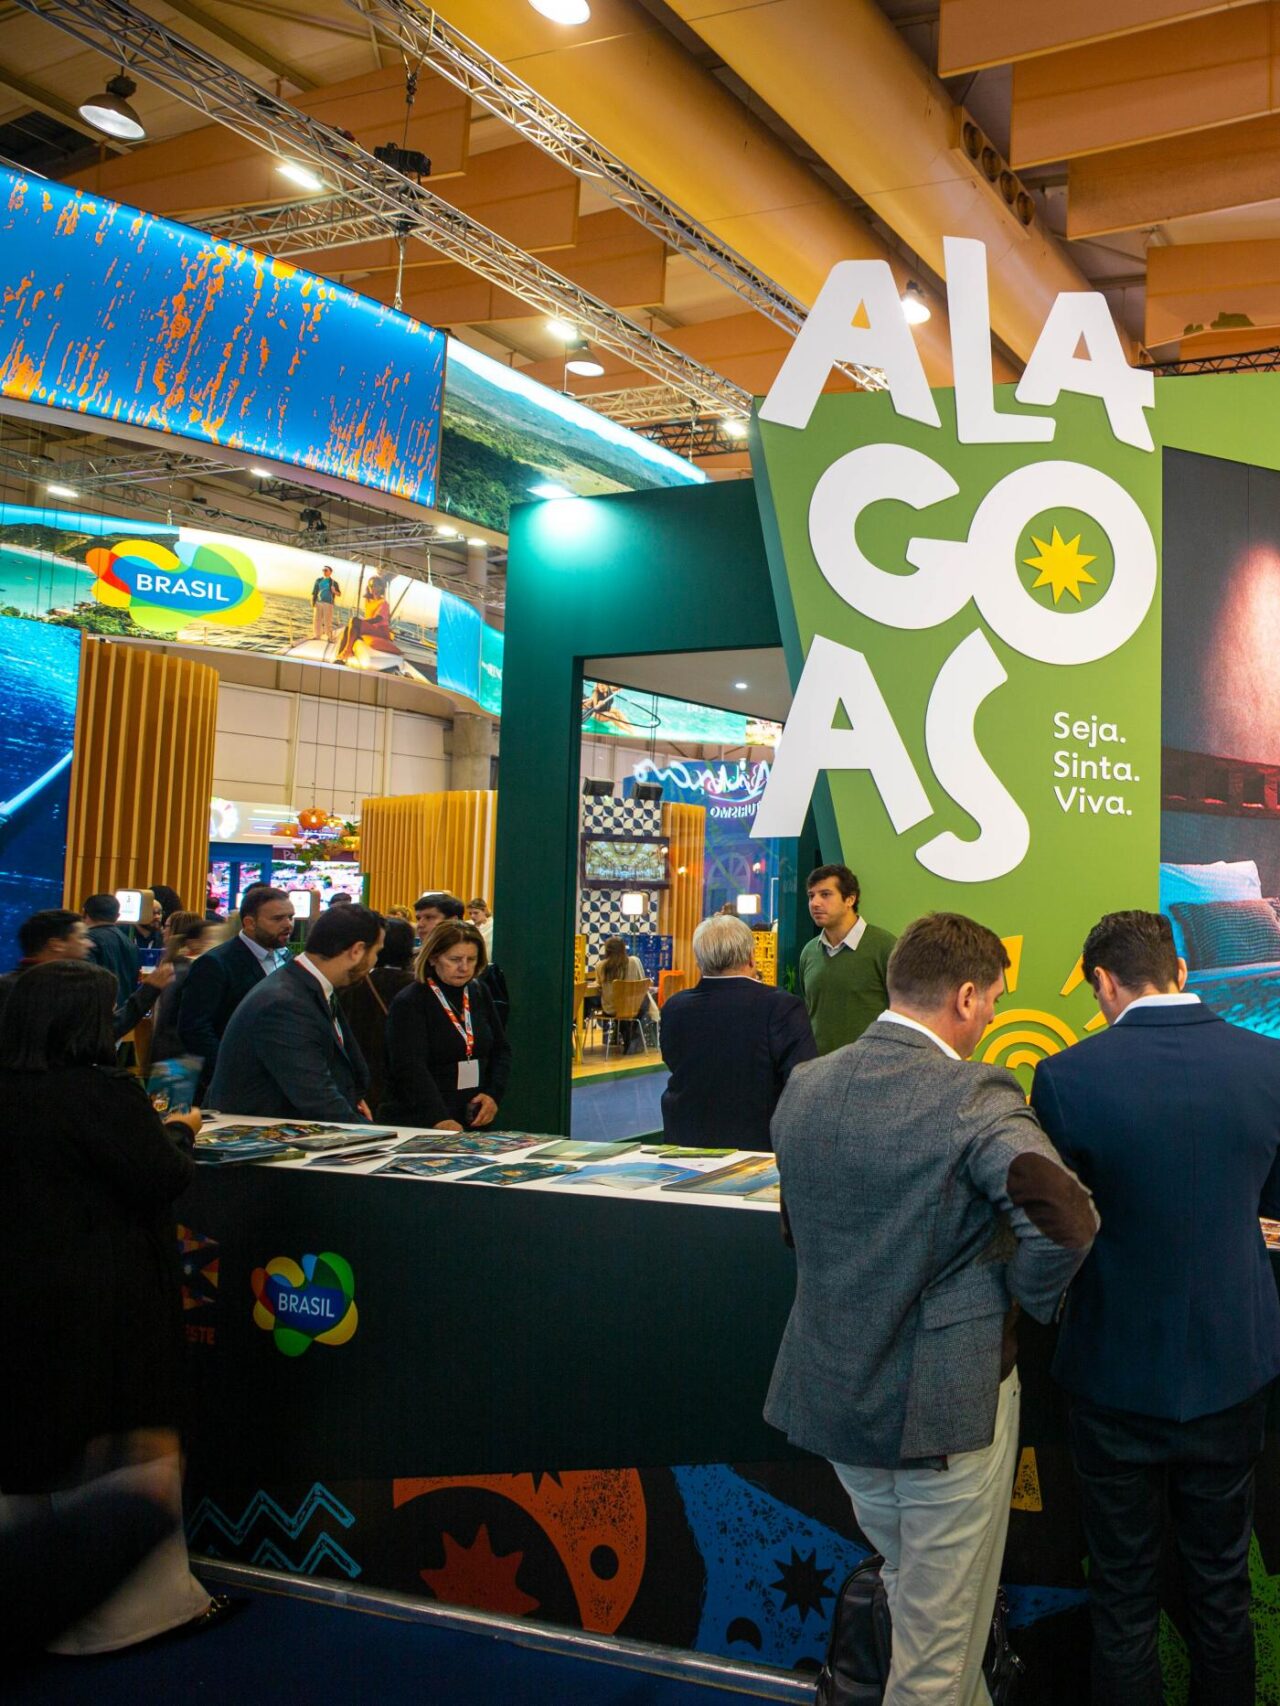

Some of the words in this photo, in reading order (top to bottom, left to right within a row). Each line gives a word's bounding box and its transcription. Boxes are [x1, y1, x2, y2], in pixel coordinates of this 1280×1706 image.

[136, 573, 230, 602] BRASIL
[1053, 711, 1127, 748] Seja.
[1053, 750, 1140, 782] Sinta.
[1053, 786, 1133, 816] Viva.
[278, 1292, 335, 1318] BRASIL
